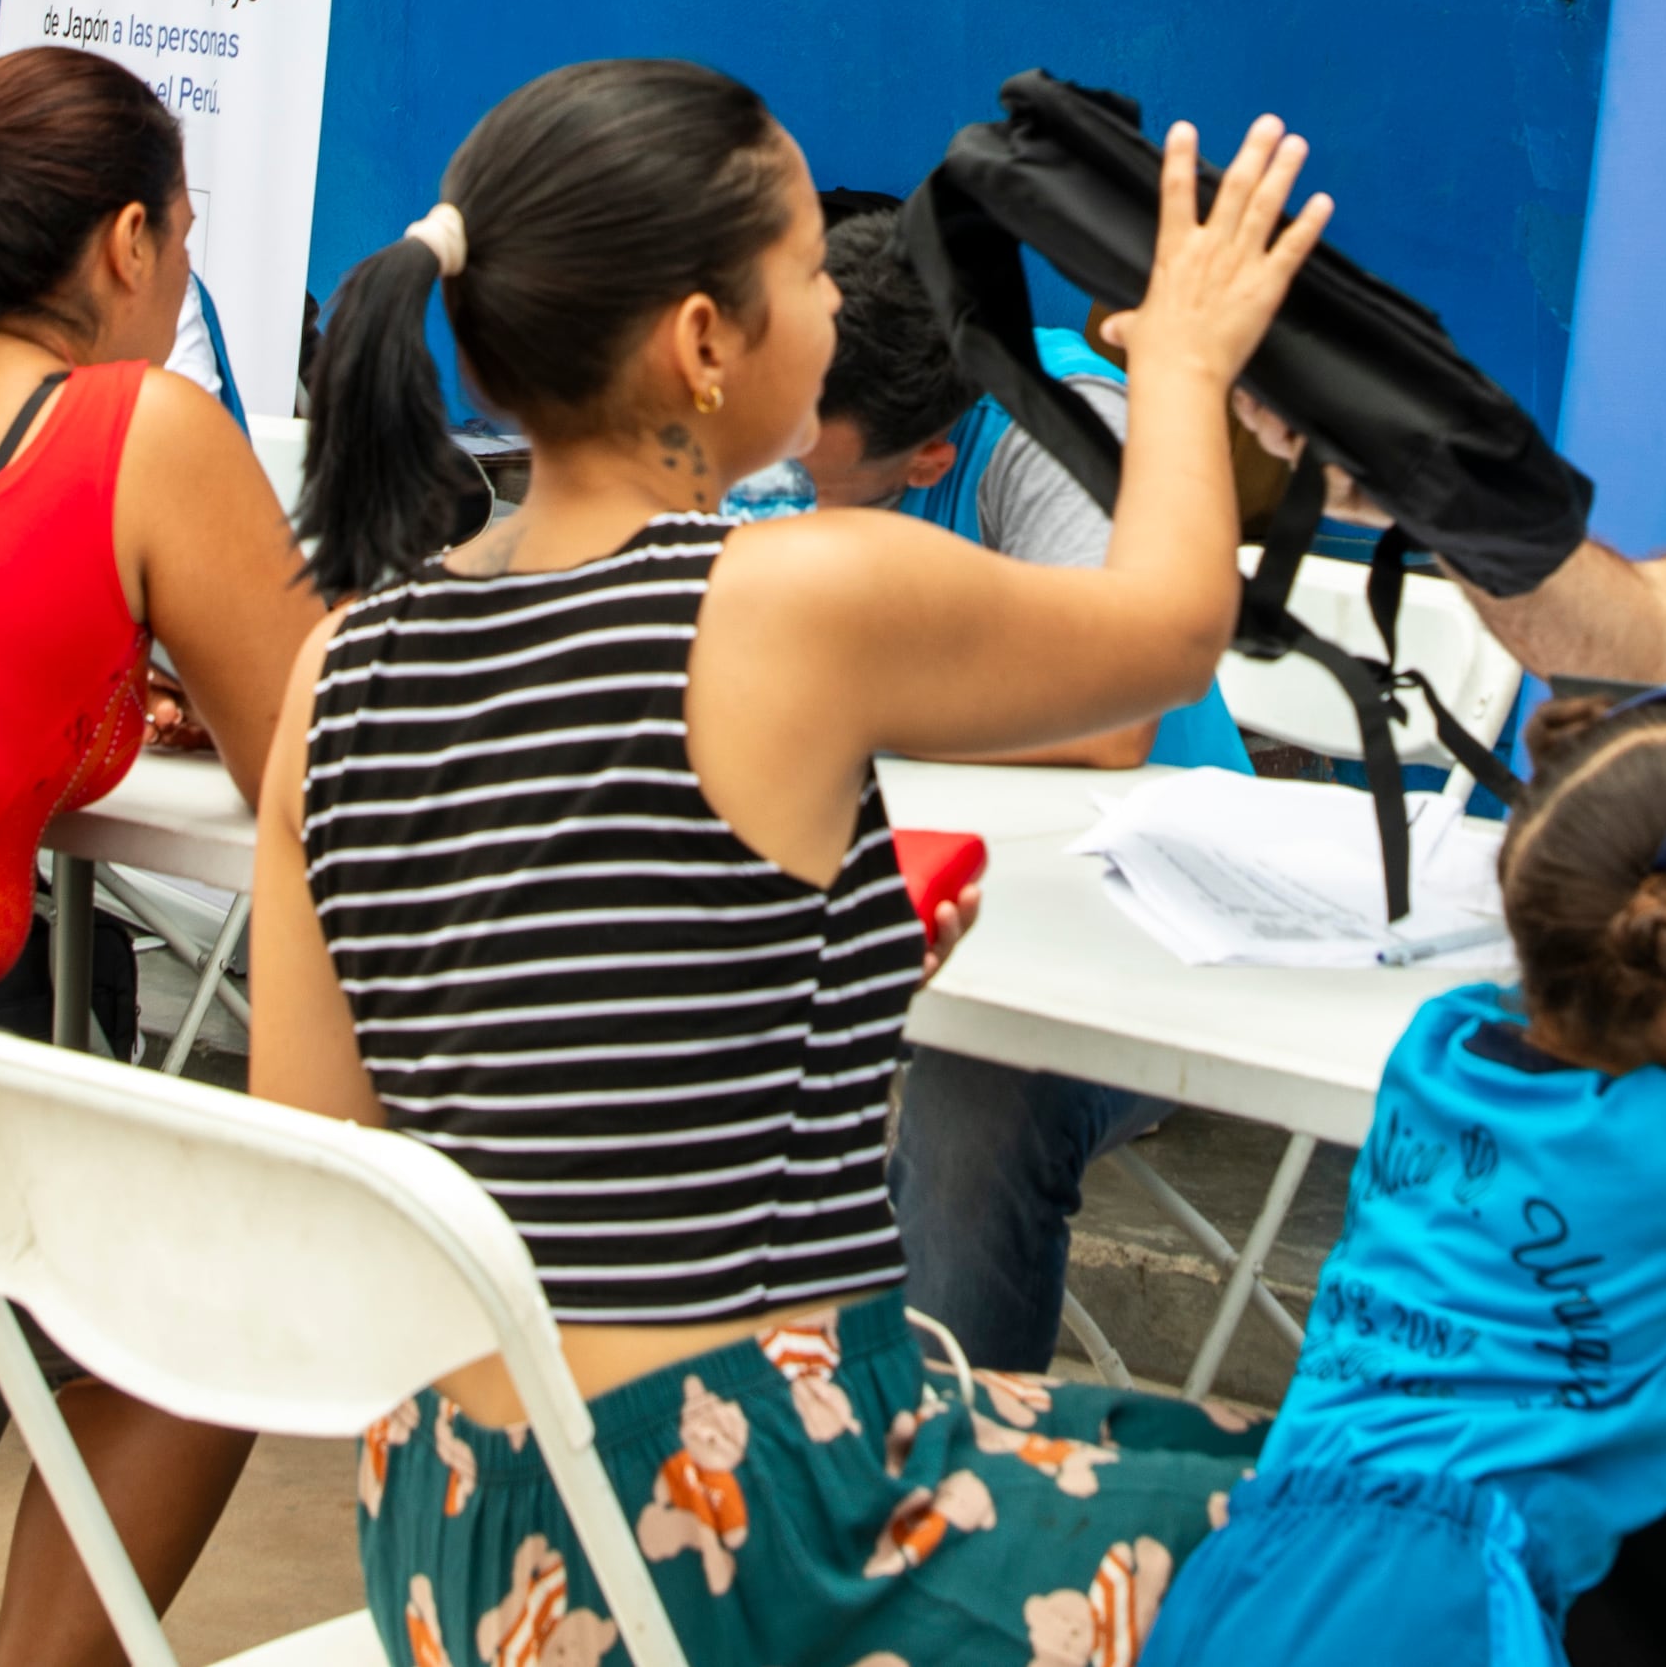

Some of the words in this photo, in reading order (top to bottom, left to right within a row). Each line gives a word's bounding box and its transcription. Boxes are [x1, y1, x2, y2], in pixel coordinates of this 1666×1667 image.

[43, 5, 59, 36] de
[62, 7, 109, 49] Japón
[112, 20, 122, 44] a
[129, 14, 153, 48] las
[156, 25, 240, 58] personas
[178, 77, 221, 115] Perú.
